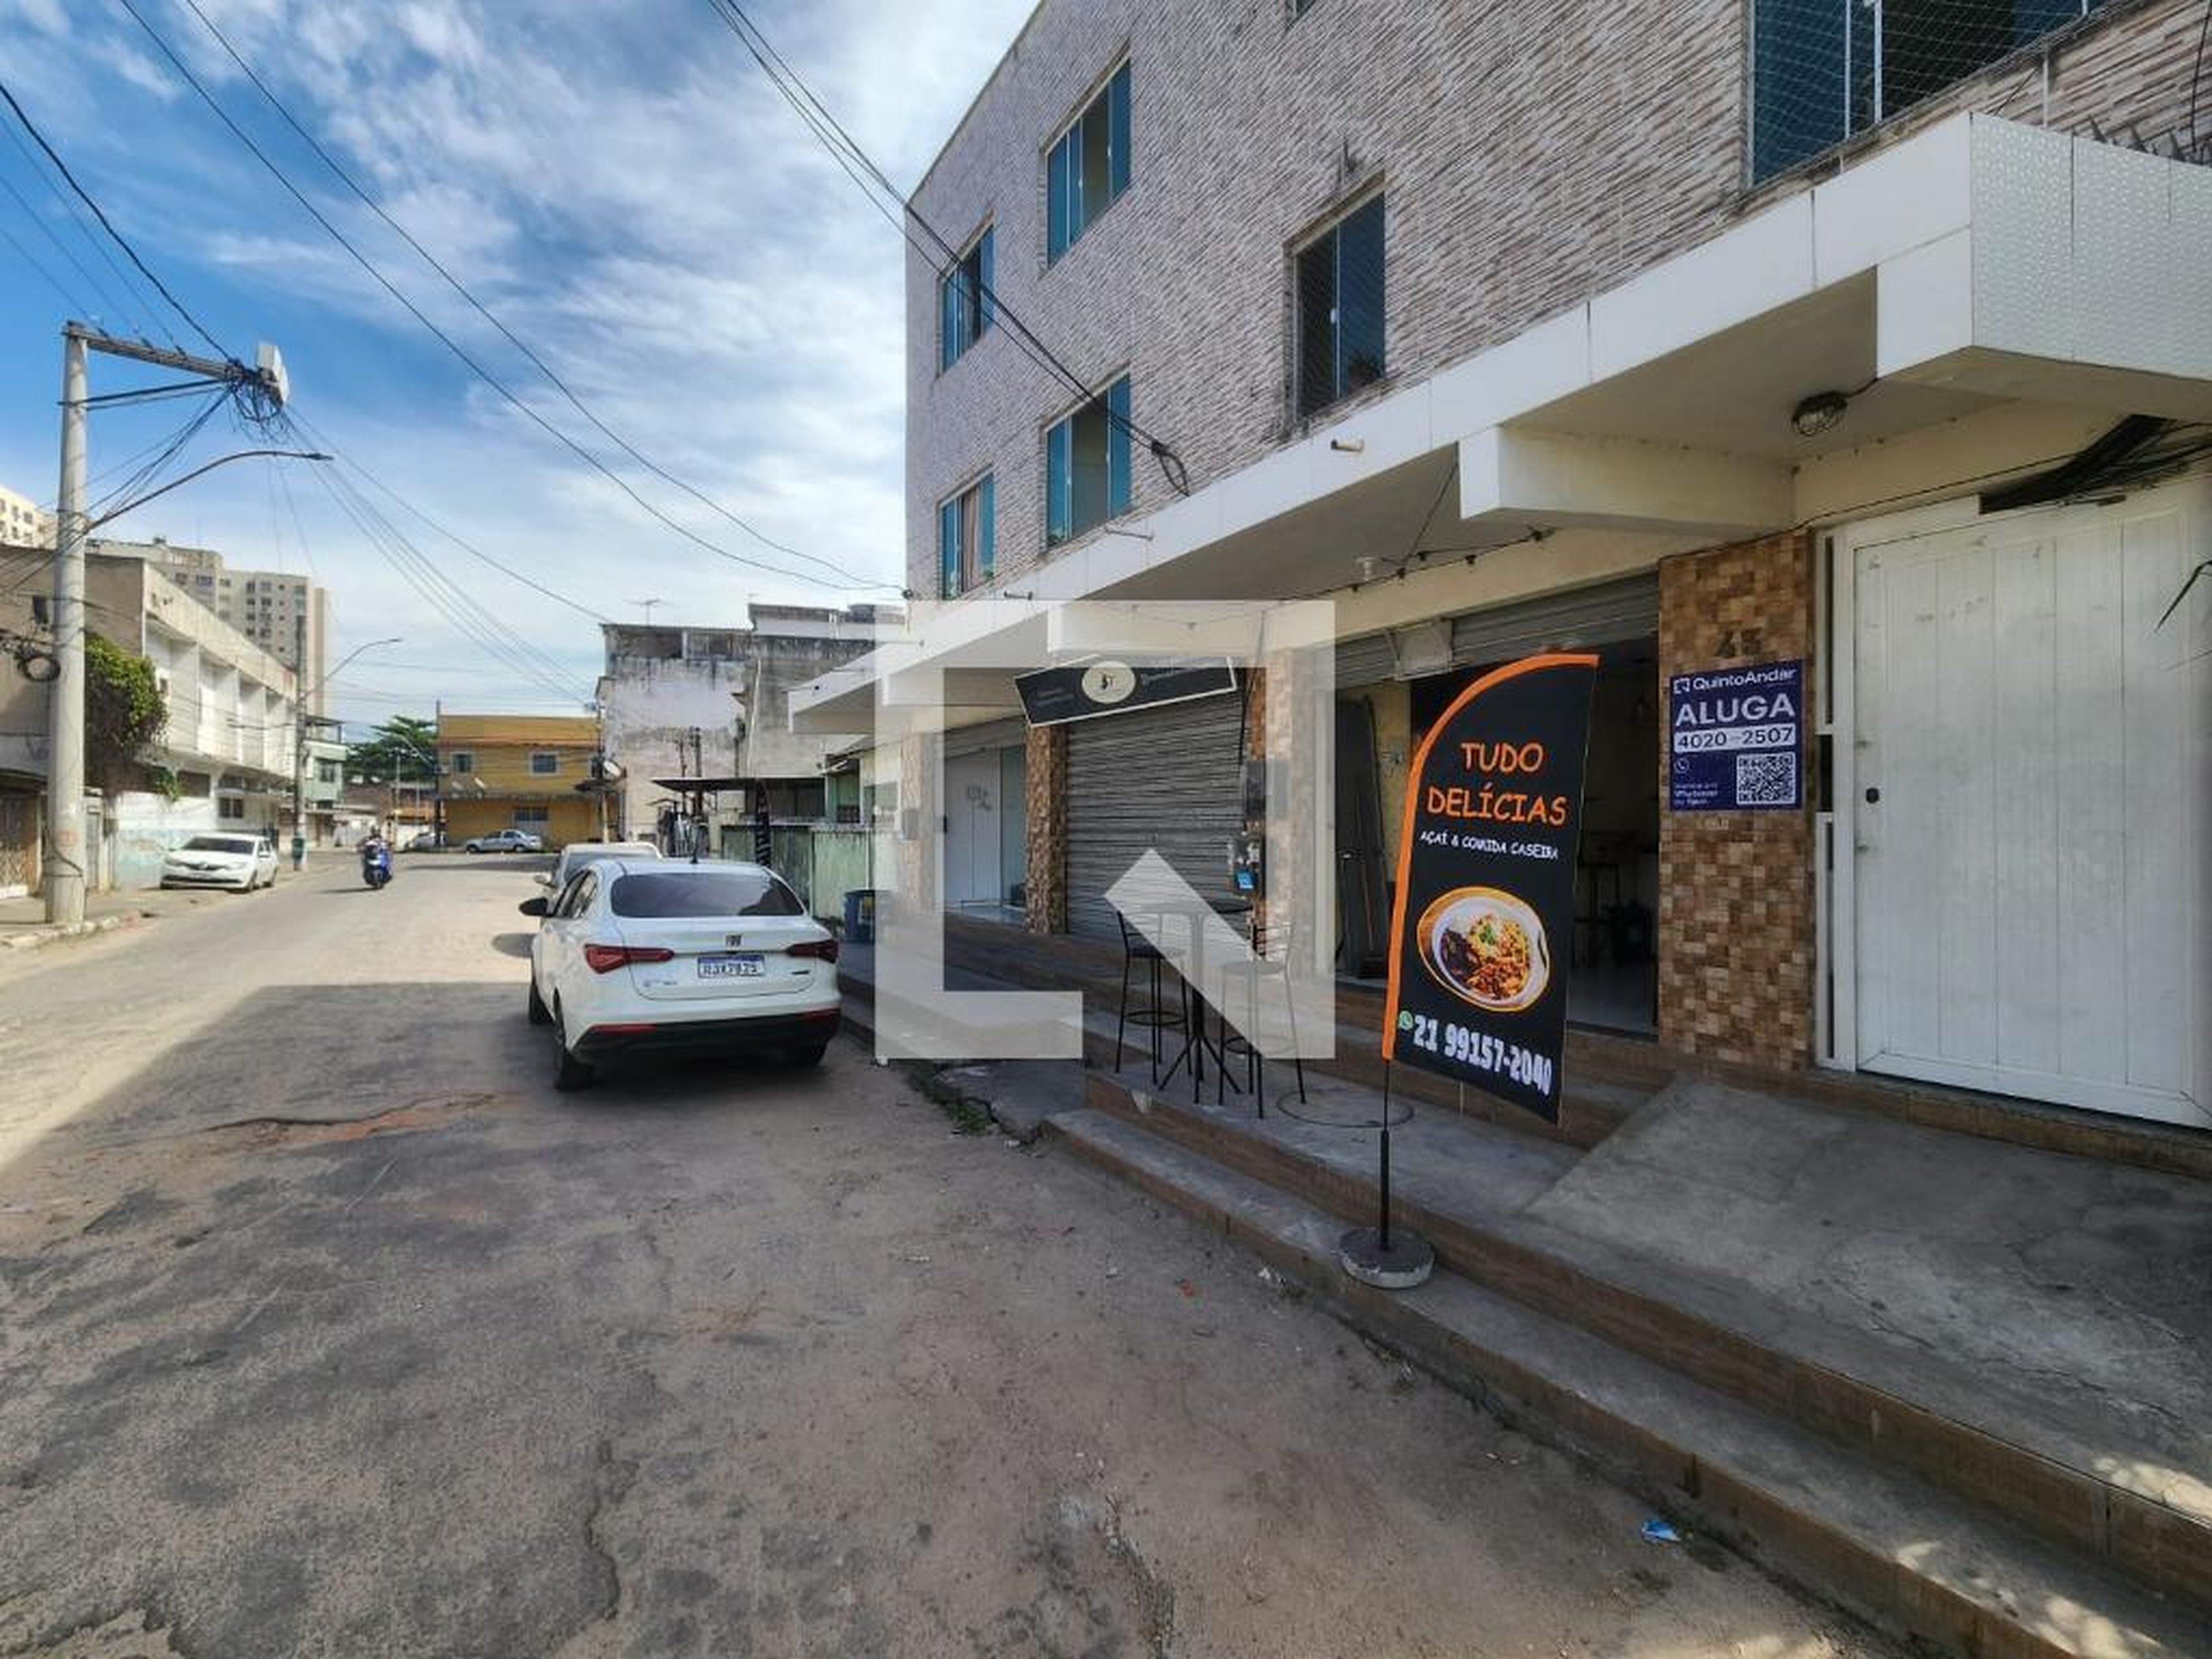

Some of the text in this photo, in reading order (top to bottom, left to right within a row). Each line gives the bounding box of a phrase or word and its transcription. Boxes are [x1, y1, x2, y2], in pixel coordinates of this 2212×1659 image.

[1692, 668, 1797, 691] QuintoAndar
[1675, 693, 1796, 727] ALUGA
[1460, 741, 1544, 772] TUDO
[1427, 781, 1567, 826] DELÍCIAS
[1413, 1014, 1553, 1096] 21 99157-2040
